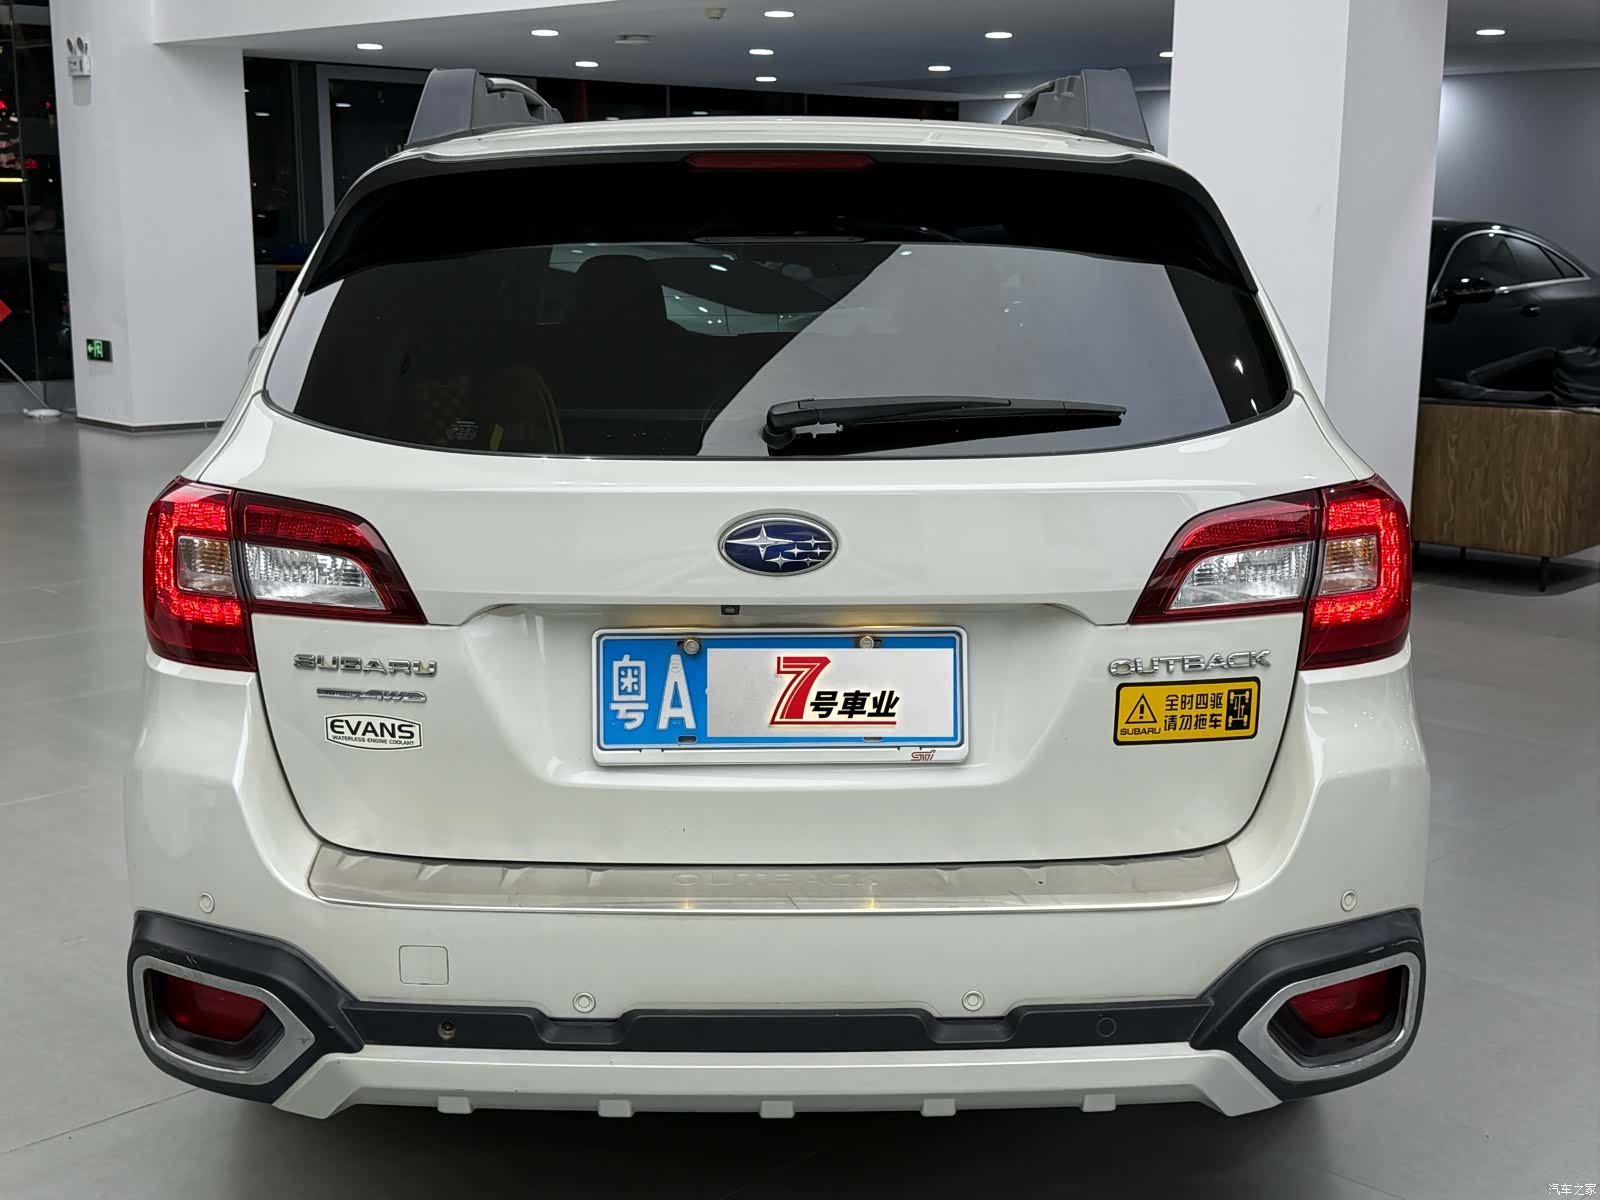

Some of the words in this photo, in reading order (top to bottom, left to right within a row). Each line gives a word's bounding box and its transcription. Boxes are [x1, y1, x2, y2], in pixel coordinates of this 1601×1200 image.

[293, 653, 437, 677] SUBARU
[1108, 649, 1272, 677] OUTBACK
[1164, 692, 1224, 711] 全时四驱
[330, 719, 414, 740] EVANS
[1119, 727, 1162, 736] SUBARU
[1163, 713, 1223, 731] 请勿拖车
[332, 734, 366, 743] WATERLESS
